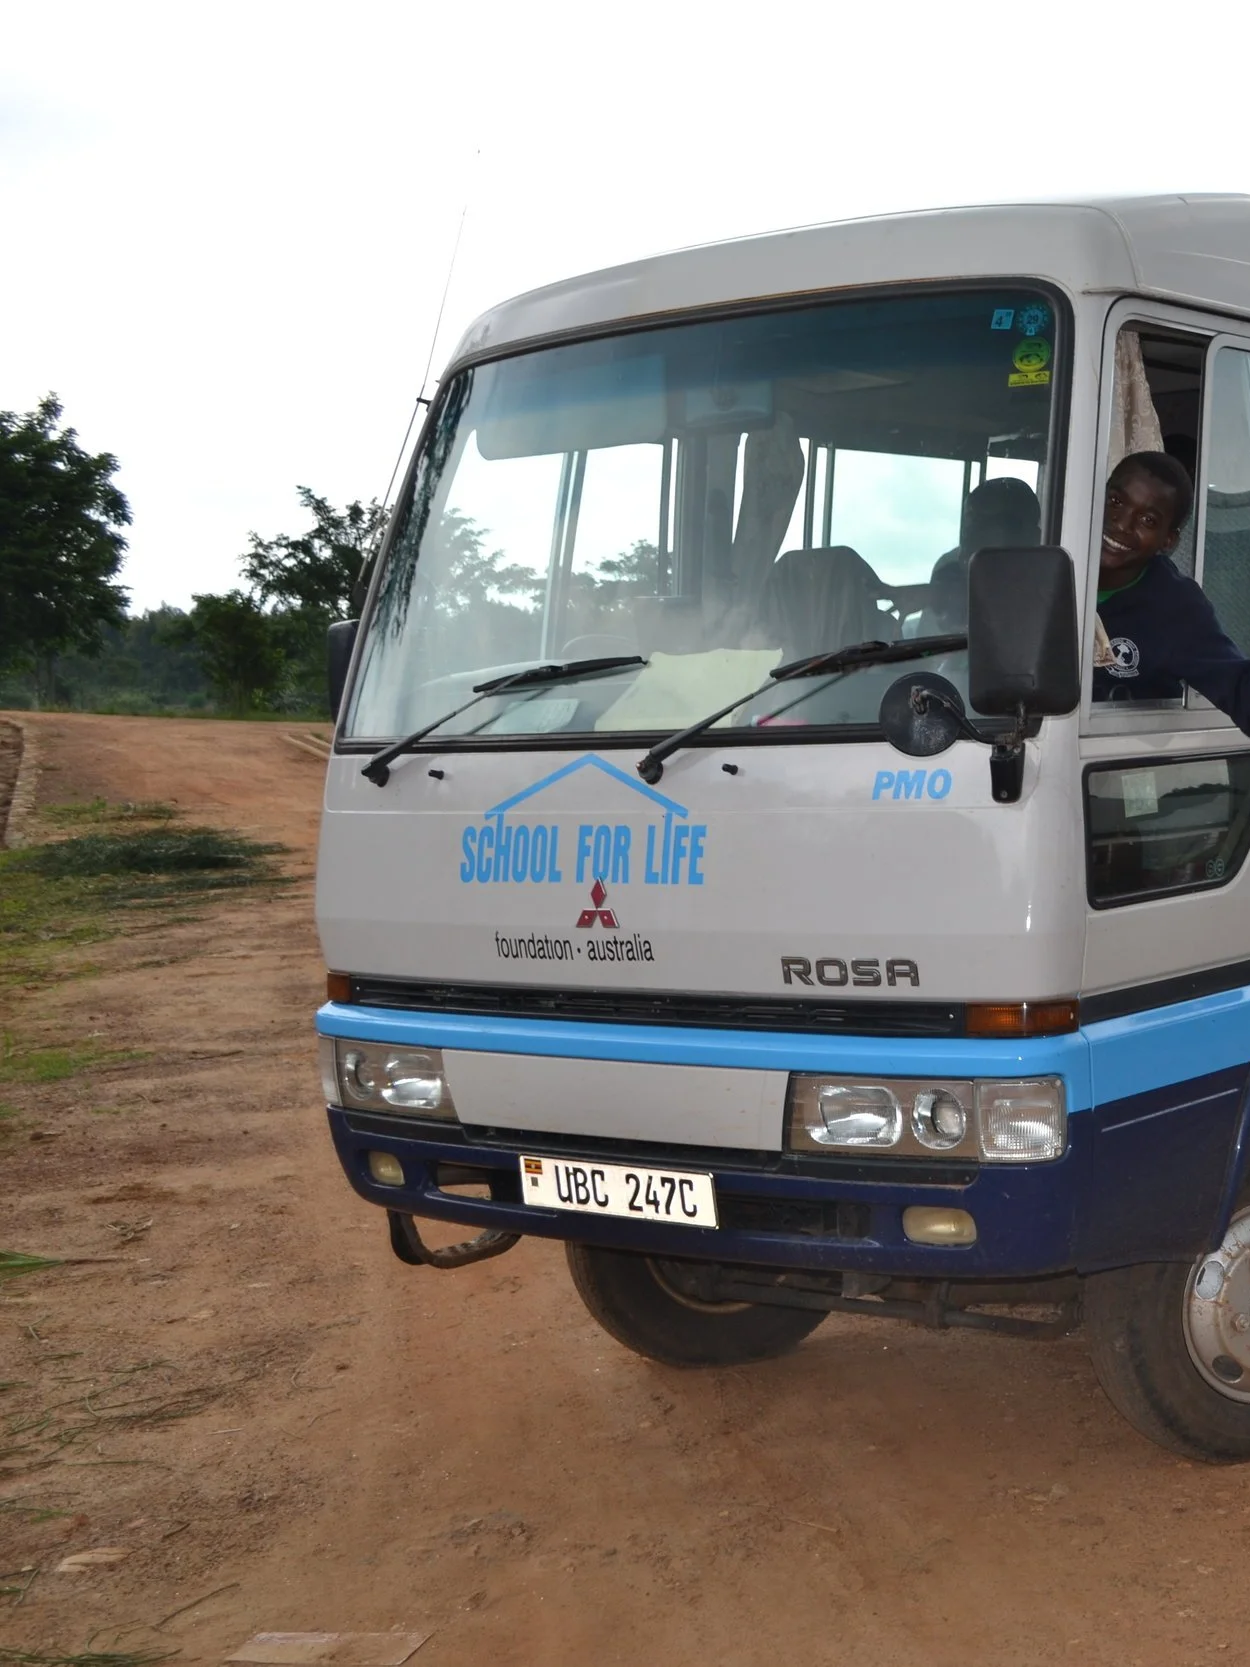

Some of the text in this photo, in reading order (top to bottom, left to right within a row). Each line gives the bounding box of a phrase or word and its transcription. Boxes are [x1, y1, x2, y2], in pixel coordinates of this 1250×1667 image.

[872, 768, 952, 801] PMO
[460, 814, 708, 886] SCHOOL FOR LIFE
[494, 931, 655, 962] foundation australia
[780, 955, 921, 988] ROSA
[554, 1165, 698, 1218] UBC 247C
